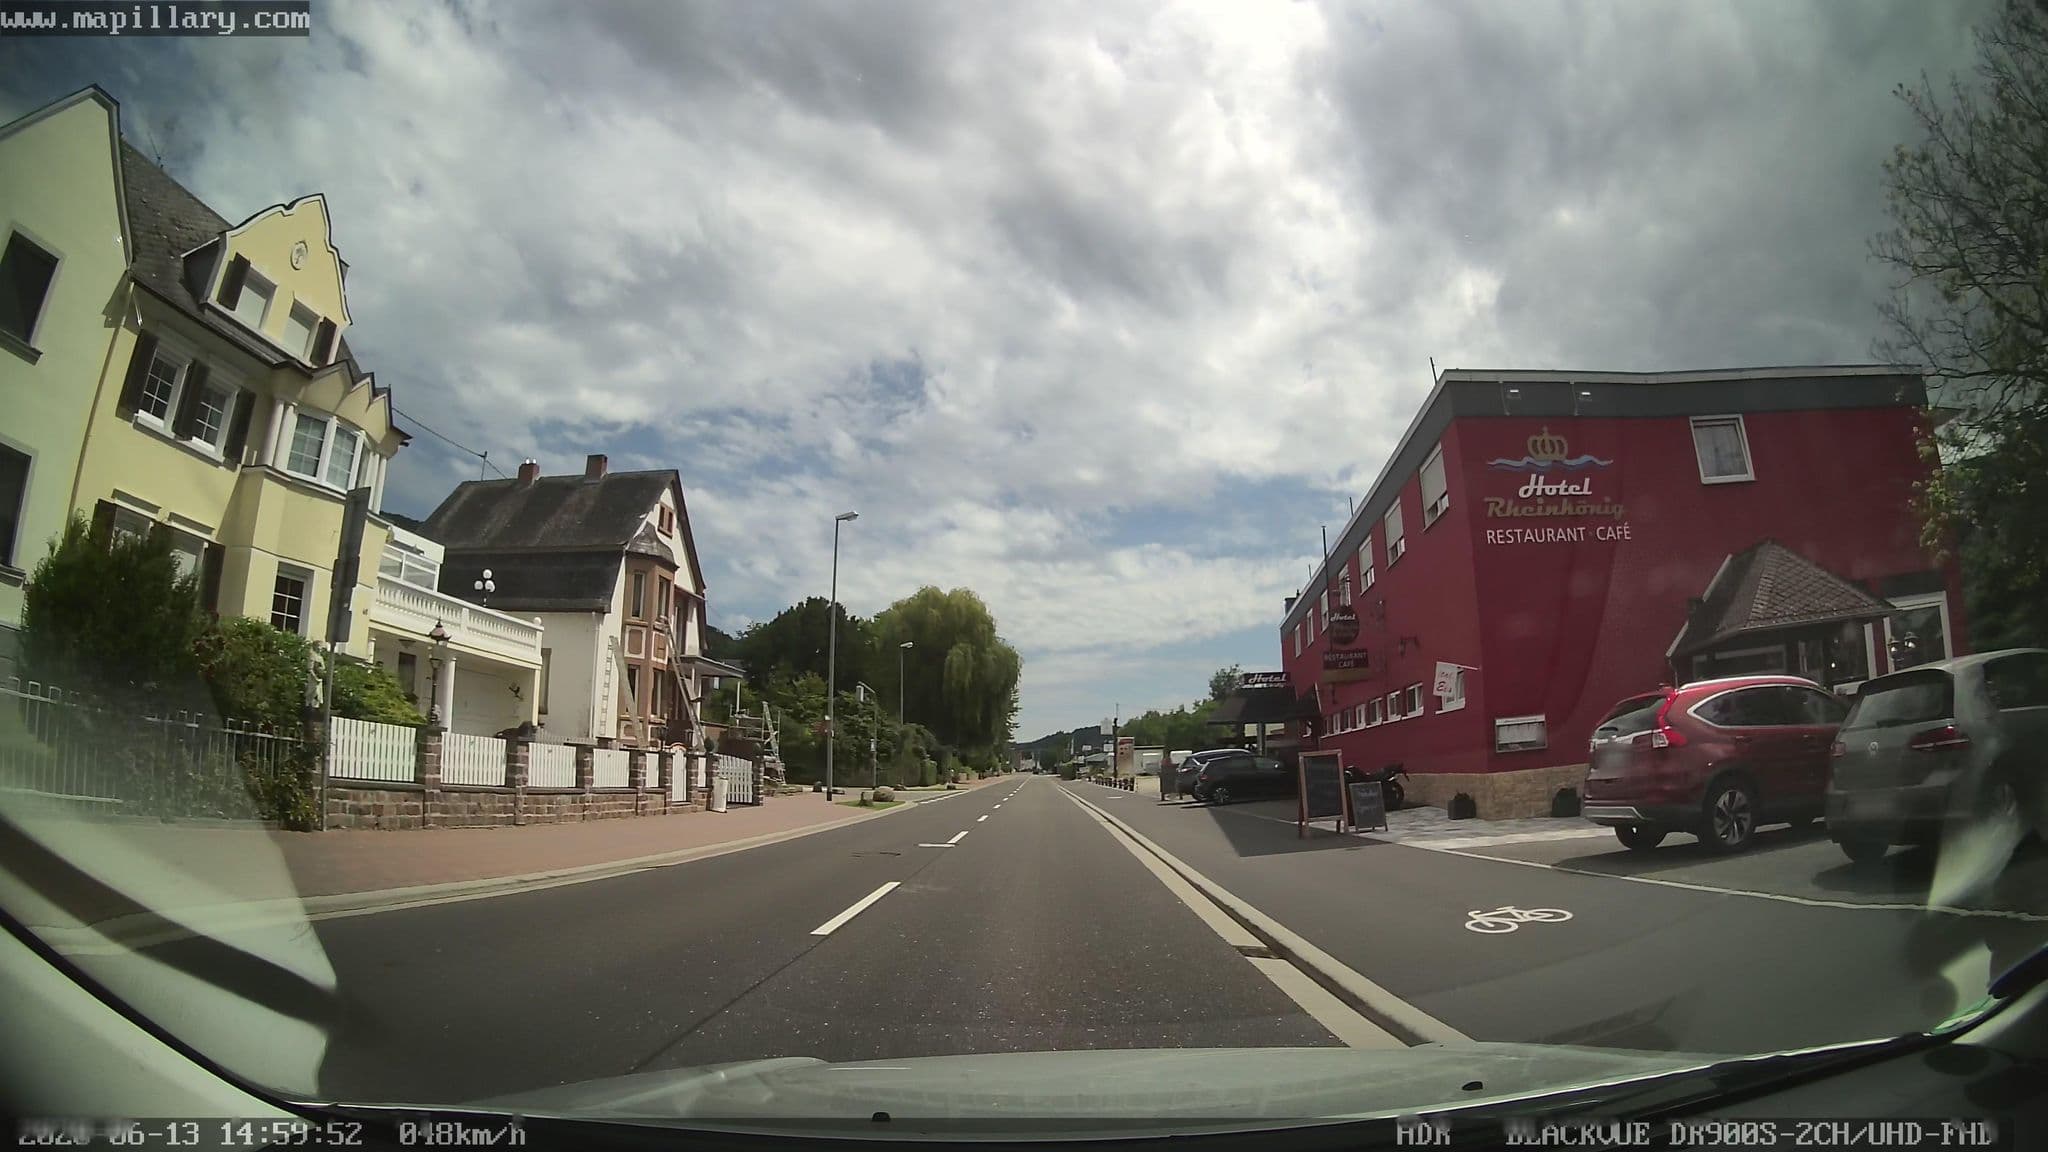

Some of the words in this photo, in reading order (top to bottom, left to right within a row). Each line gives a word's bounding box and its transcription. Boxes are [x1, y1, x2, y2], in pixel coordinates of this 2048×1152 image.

[1518, 473, 1592, 498] Hotel
[1486, 526, 1586, 545] RESTAURANT
[1596, 522, 1632, 541] CAFÉ
[1248, 673, 1287, 684] Hotel
